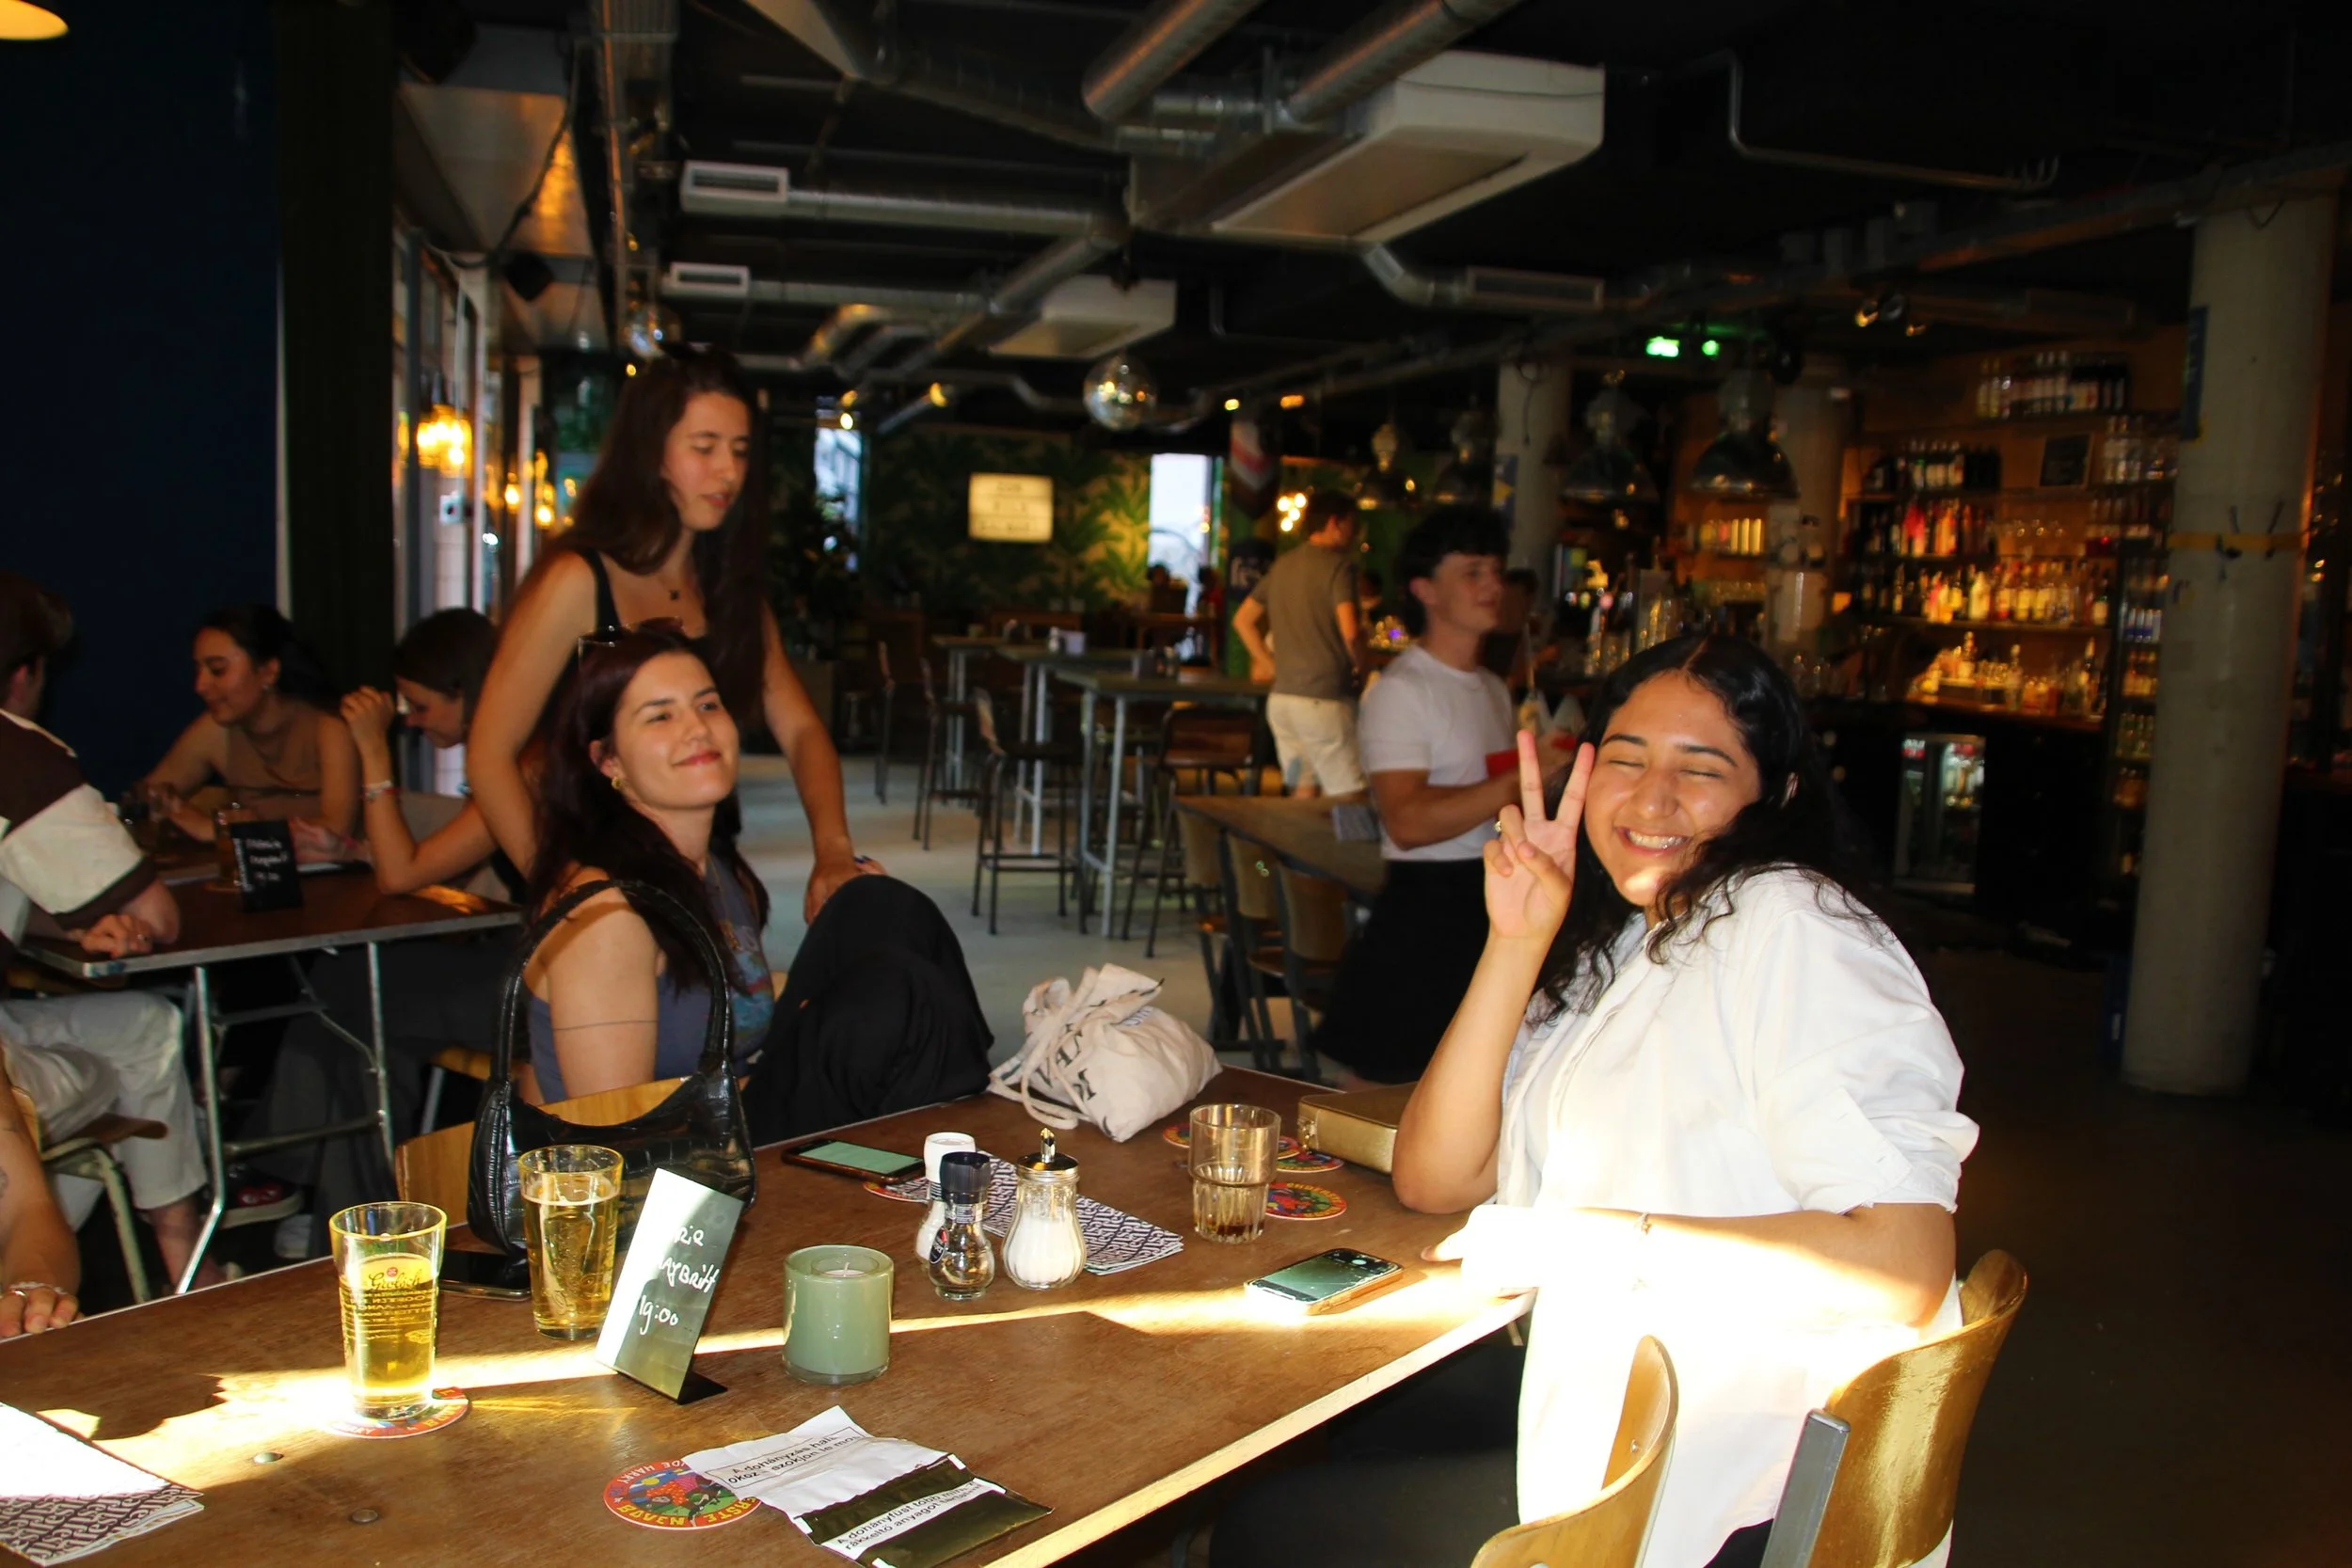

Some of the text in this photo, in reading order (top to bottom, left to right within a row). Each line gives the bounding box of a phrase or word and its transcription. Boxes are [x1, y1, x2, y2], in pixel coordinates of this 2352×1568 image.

[771, 1449, 819, 1471] szokjon
[616, 1464, 656, 1484] HARRY
[894, 1502, 941, 1527] anyagot
